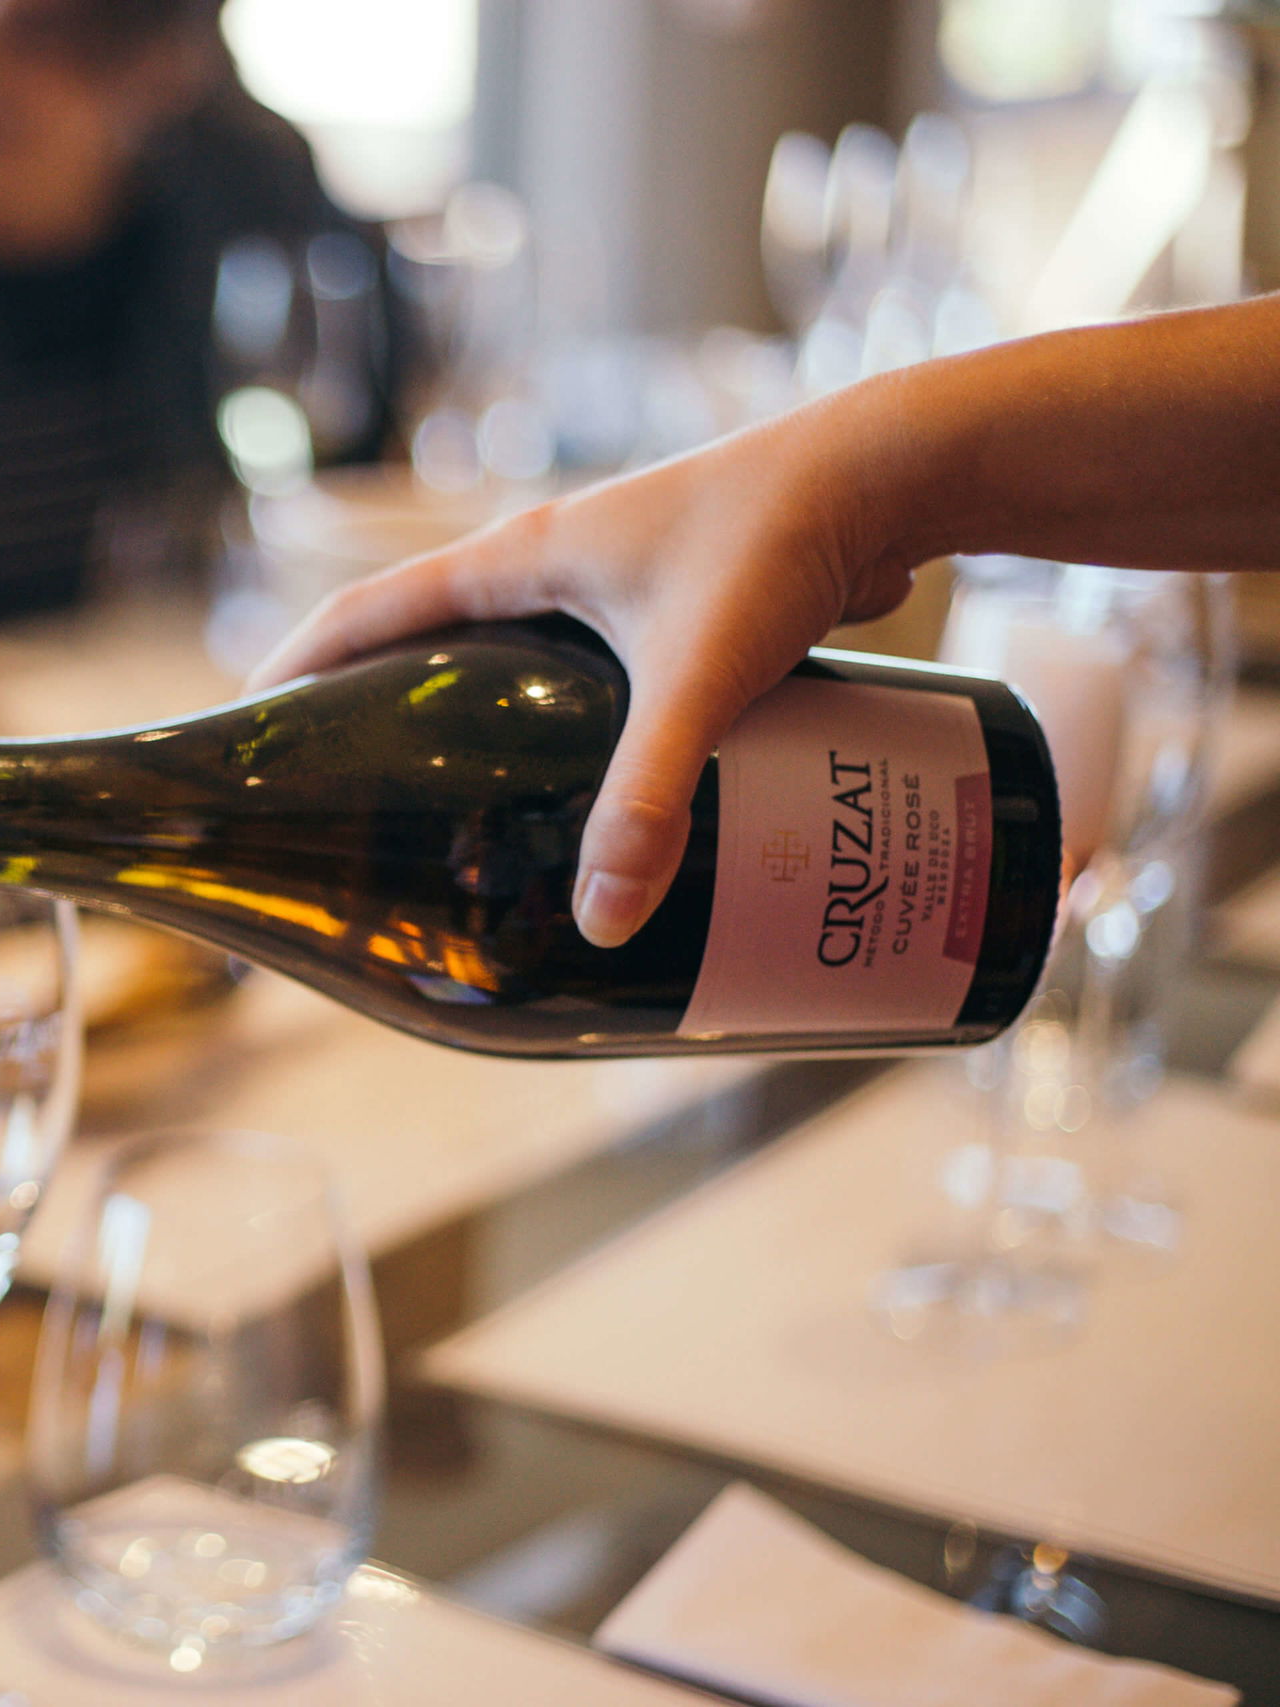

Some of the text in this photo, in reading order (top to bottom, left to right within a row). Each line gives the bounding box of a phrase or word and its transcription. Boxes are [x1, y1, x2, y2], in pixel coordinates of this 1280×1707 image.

[817, 750, 889, 967] CRUZAT
[878, 758, 892, 871] TRADICIONAL
[892, 774, 921, 955] CUVÉE ROSÉ
[922, 810, 940, 922] VALLE DE UCO
